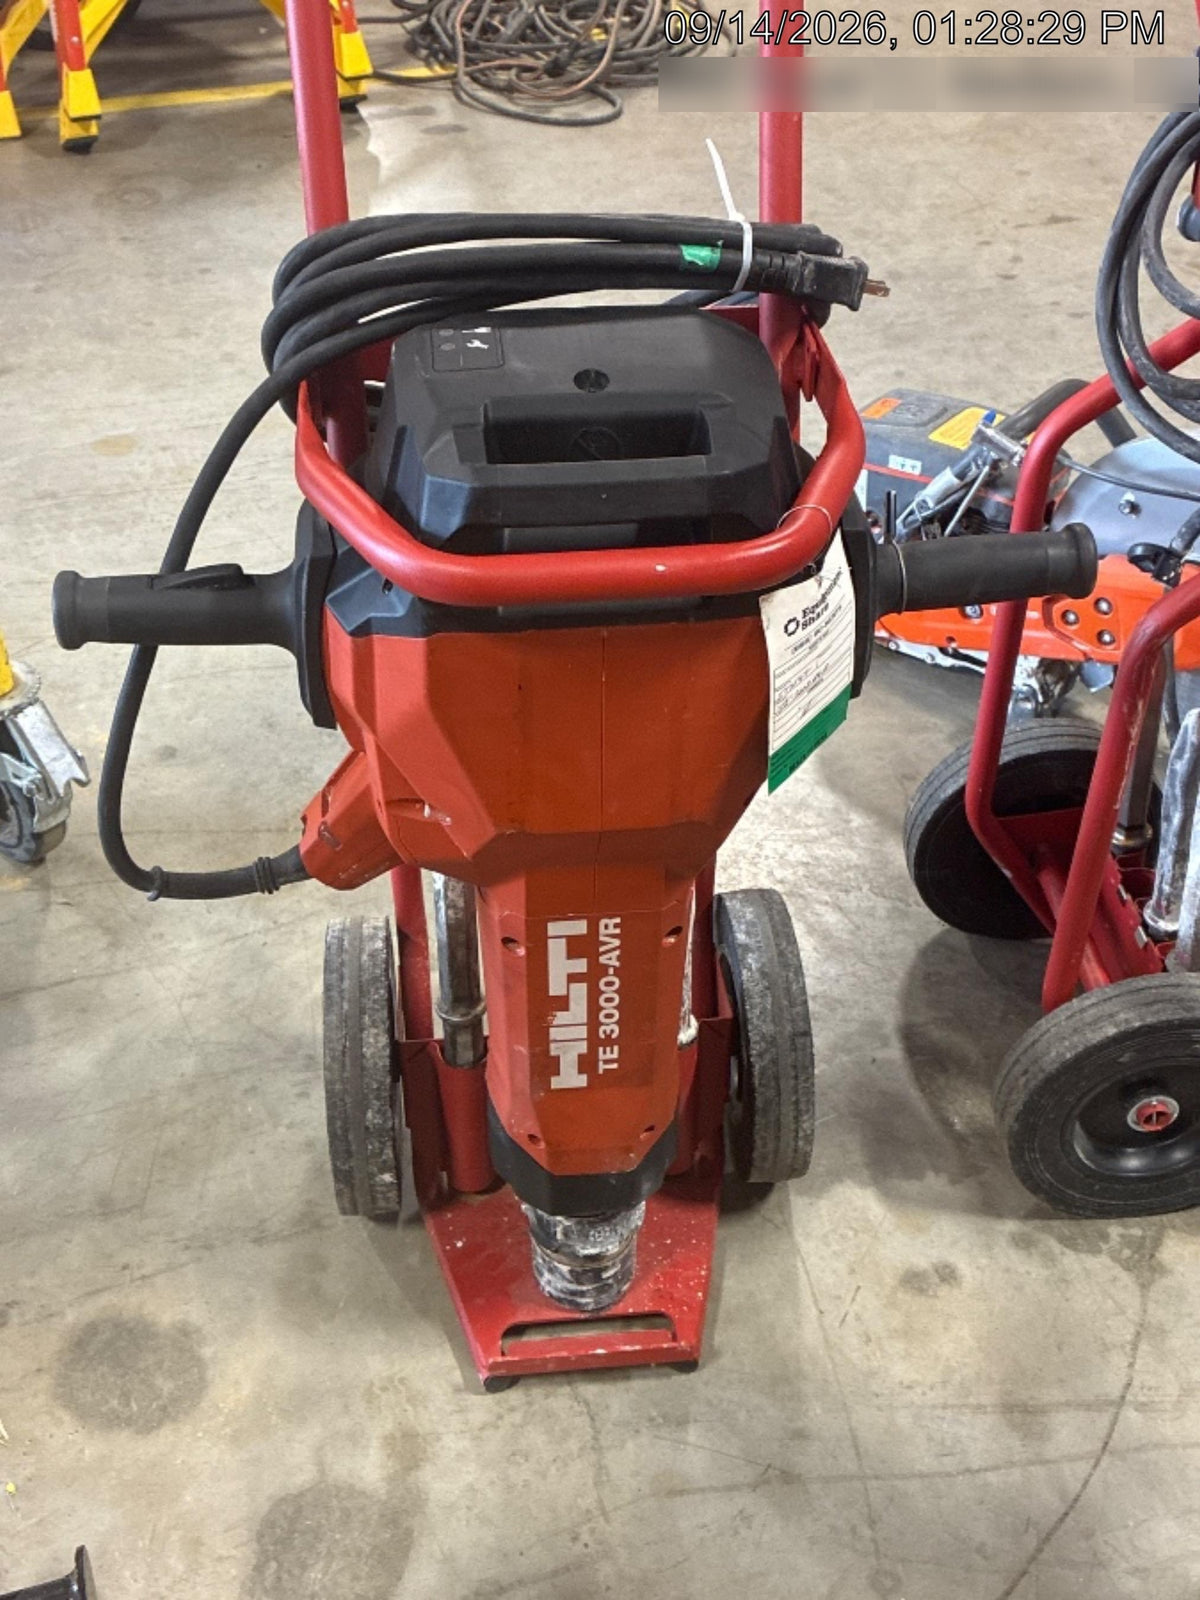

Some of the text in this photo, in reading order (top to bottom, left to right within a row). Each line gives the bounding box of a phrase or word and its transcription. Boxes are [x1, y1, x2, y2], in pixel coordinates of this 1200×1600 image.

[547, 919, 588, 1089] HILTI
[598, 917, 621, 1075] TE 3000-AVR
